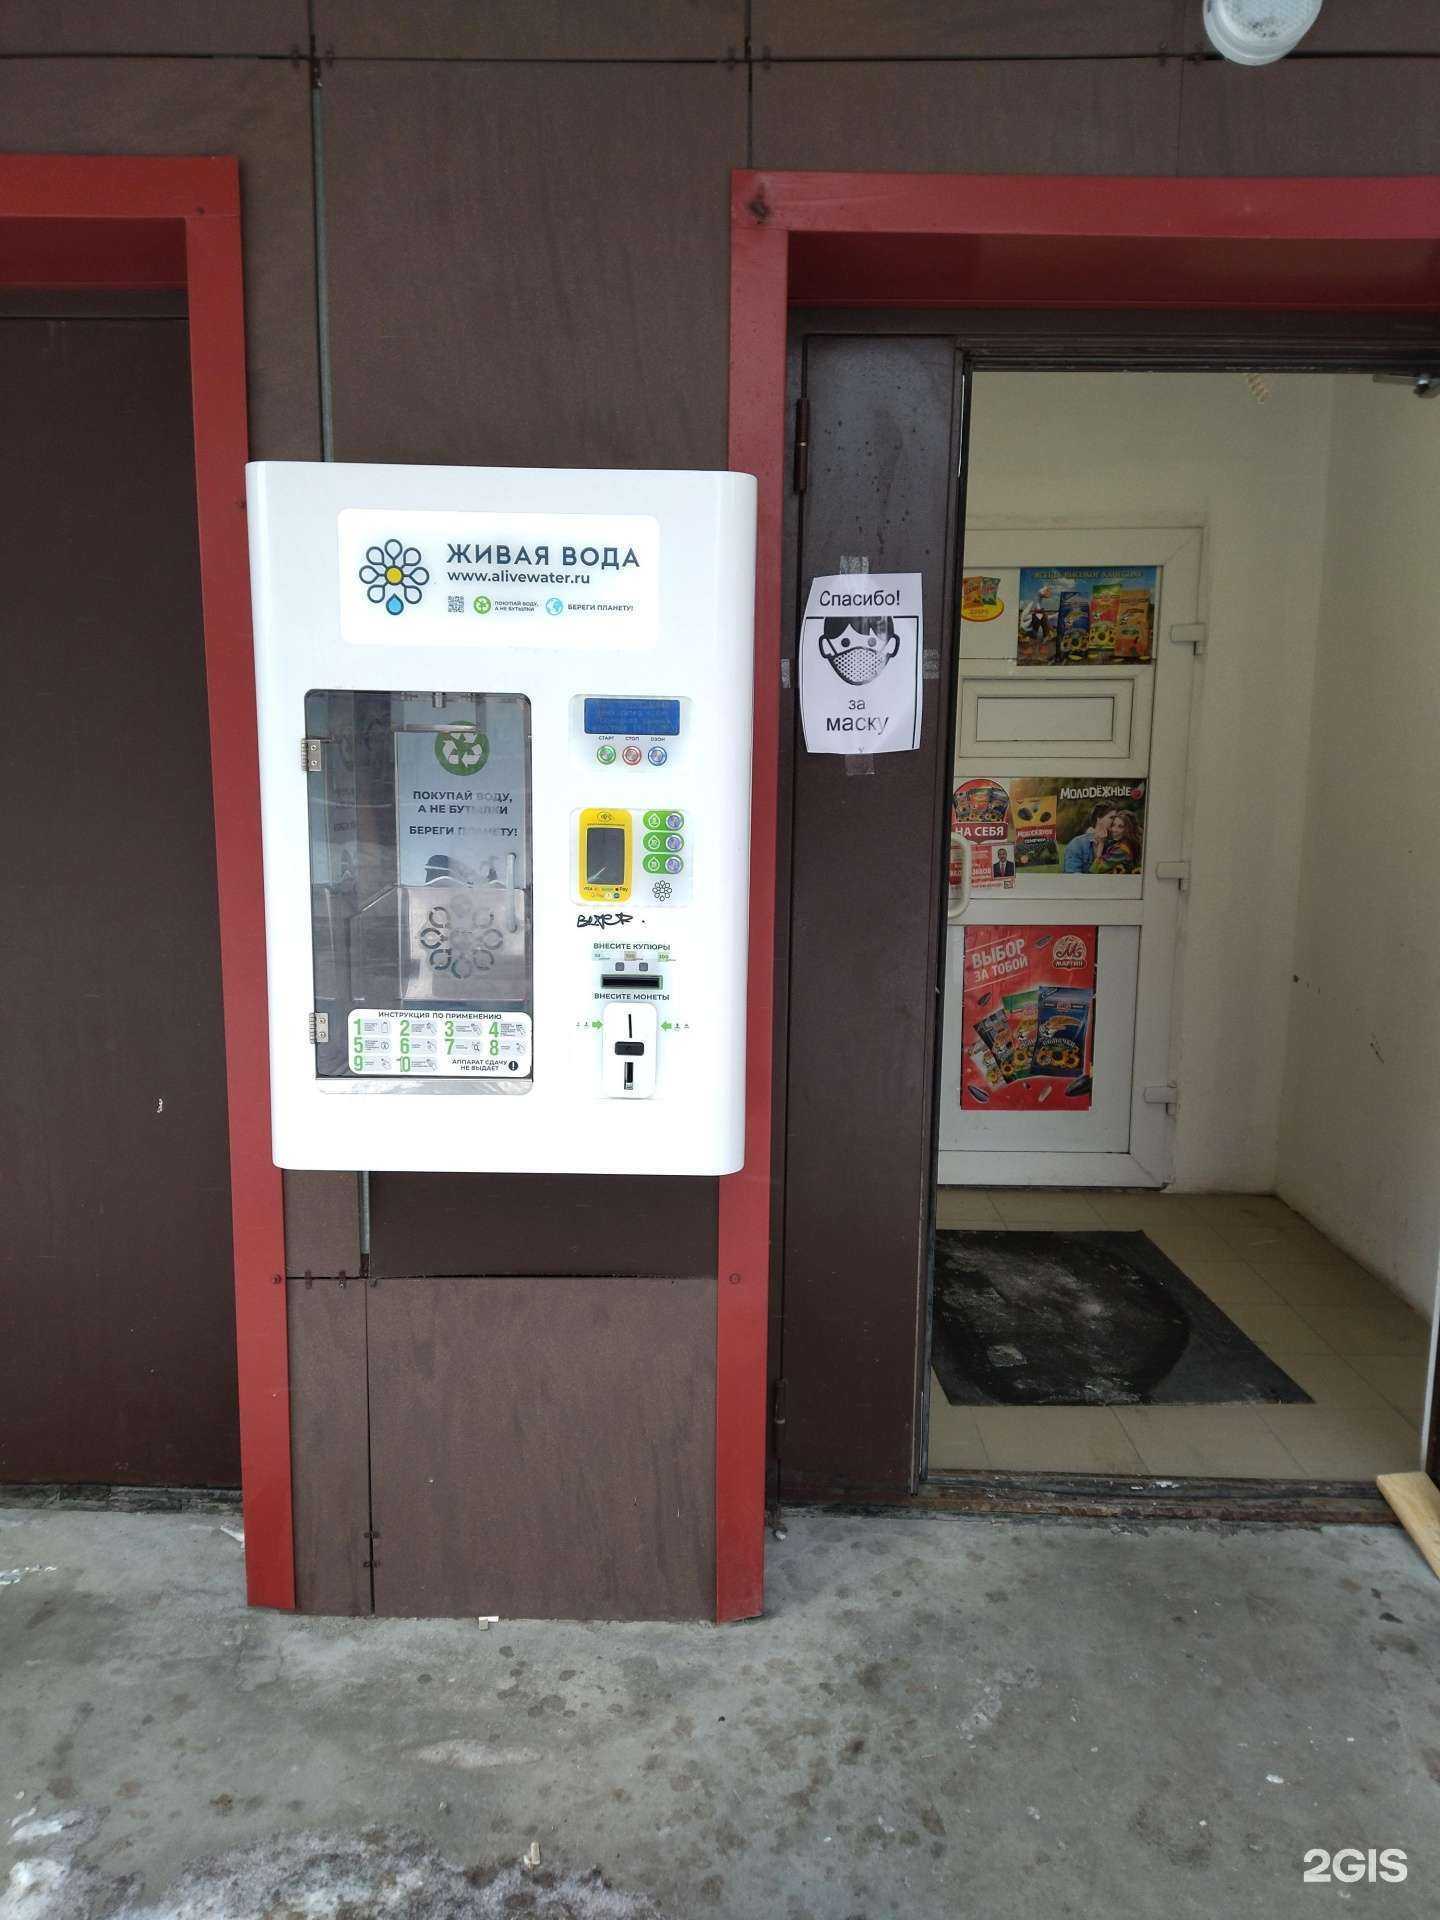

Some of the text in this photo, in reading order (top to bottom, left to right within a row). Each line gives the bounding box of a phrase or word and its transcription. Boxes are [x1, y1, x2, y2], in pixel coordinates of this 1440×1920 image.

[447, 543, 641, 570] ЖИВАЯ ВОДА
[447, 570, 590, 585] www.alivewater.ru
[820, 590, 900, 607] Спасибо!
[848, 699, 865, 710] за
[826, 716, 889, 735] маску
[413, 790, 472, 800] ПОКУПАЙ
[418, 804, 426, 813] А
[430, 805, 445, 813] НЕ
[409, 825, 454, 835] БЕРЕГИ
[974, 826, 1004, 838] СЕБЯ
[633, 943, 671, 951] КУПЮРЫ
[971, 939, 1026, 969] ВЫБОР
[974, 956, 1029, 984] ЗА ТОБОЙ
[594, 992, 670, 1001] ВНЕСИТЕ МОНЕТЫ
[378, 1011, 430, 1020] ИНСТРУКЦИЯ
[446, 1012, 502, 1020] ПРИМЕНЕНИЮ
[353, 1018, 361, 1035] 1
[400, 1020, 410, 1037] 2
[444, 1020, 454, 1037] 3
[489, 1021, 499, 1038] 4
[354, 1037, 363, 1053] 5
[400, 1038, 410, 1054] 6
[444, 1038, 454, 1055] 7
[490, 1039, 499, 1056] 8
[354, 1055, 363, 1072] 9
[396, 1056, 411, 1072] 10
